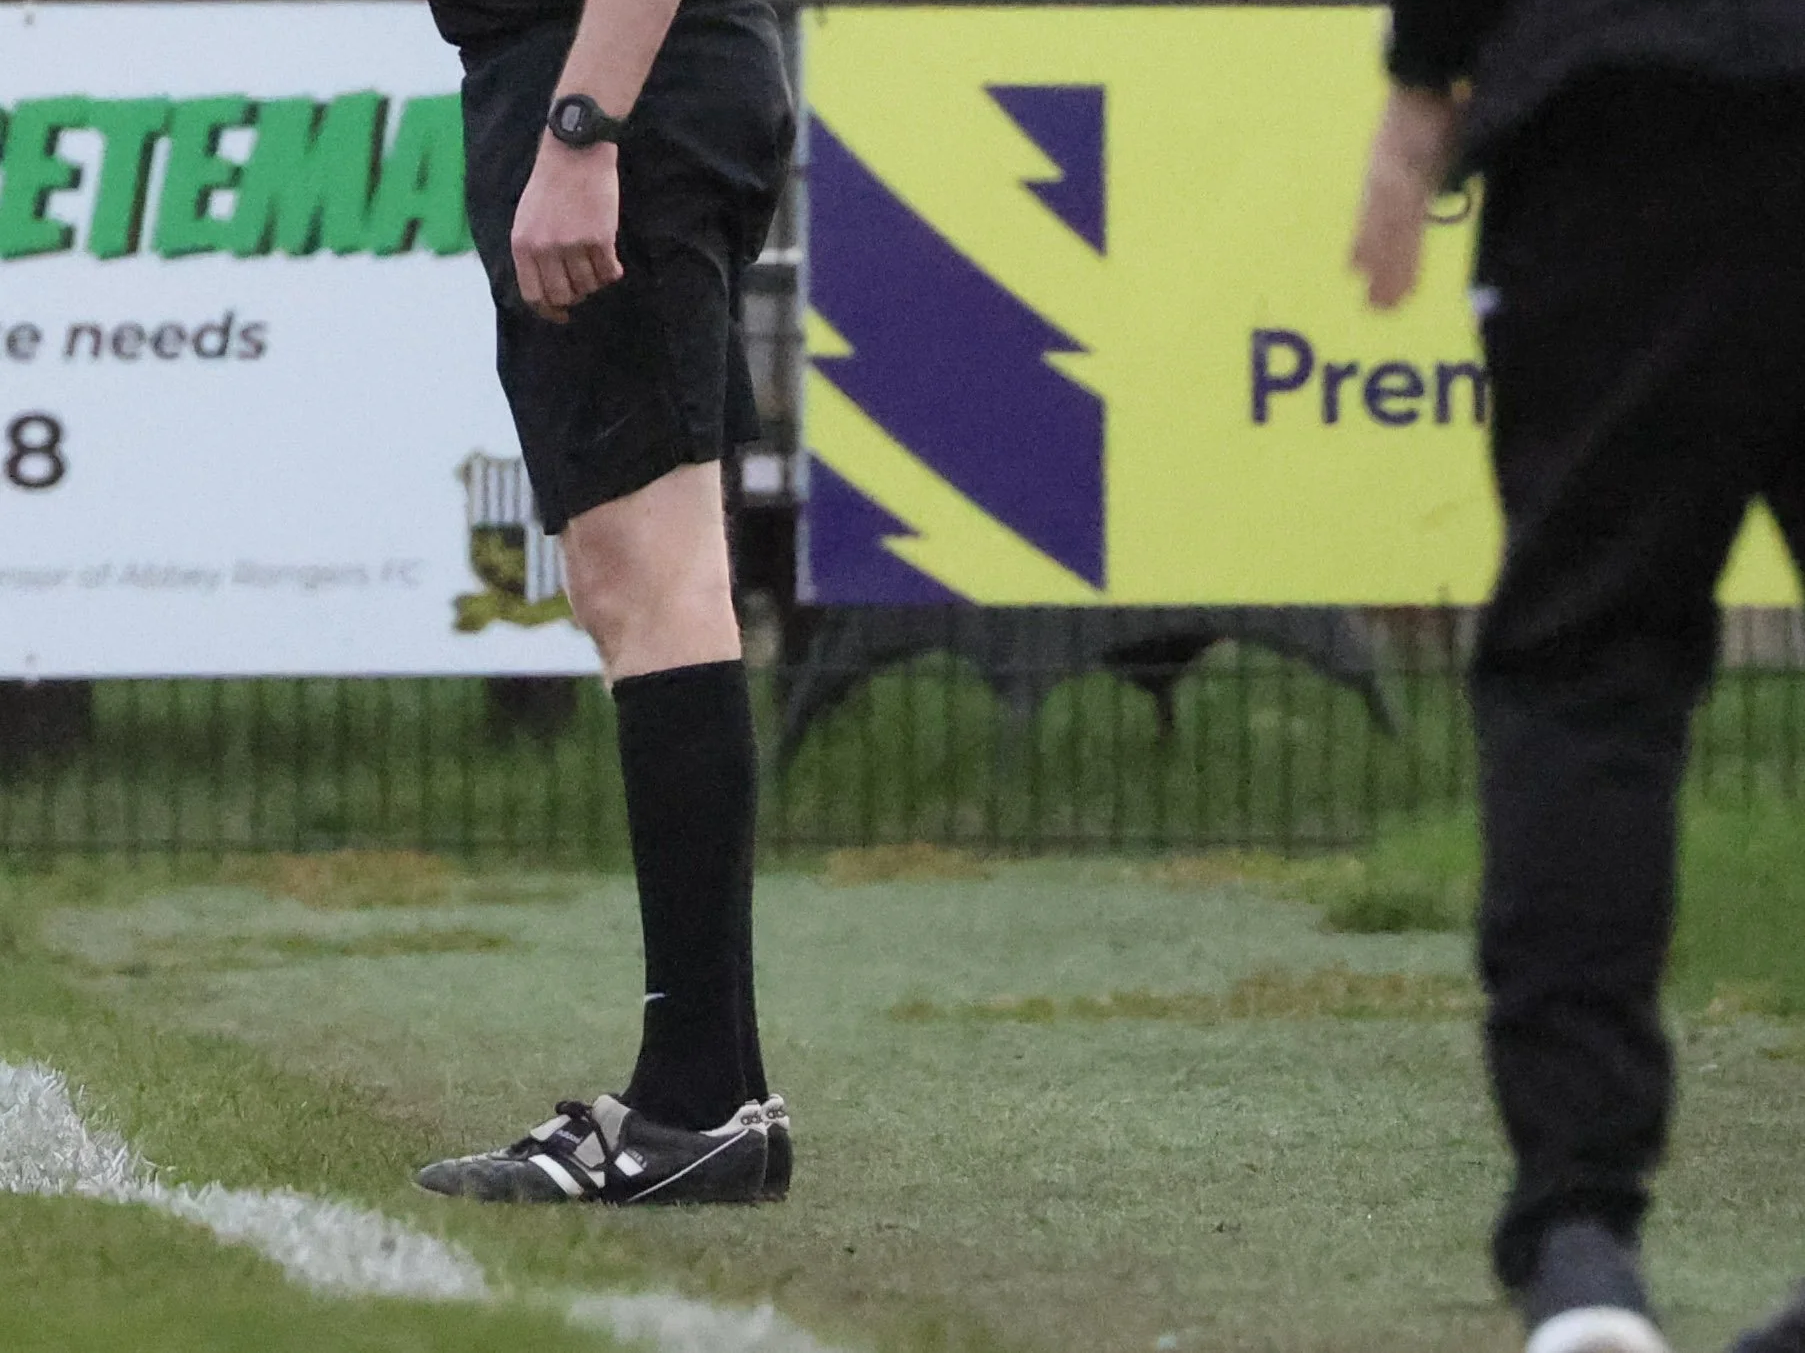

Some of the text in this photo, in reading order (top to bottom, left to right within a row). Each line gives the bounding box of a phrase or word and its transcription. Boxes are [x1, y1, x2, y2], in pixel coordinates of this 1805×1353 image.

[0, 91, 480, 260] ETEMA
[64, 307, 267, 361] needs
[5, 411, 66, 490] 8
